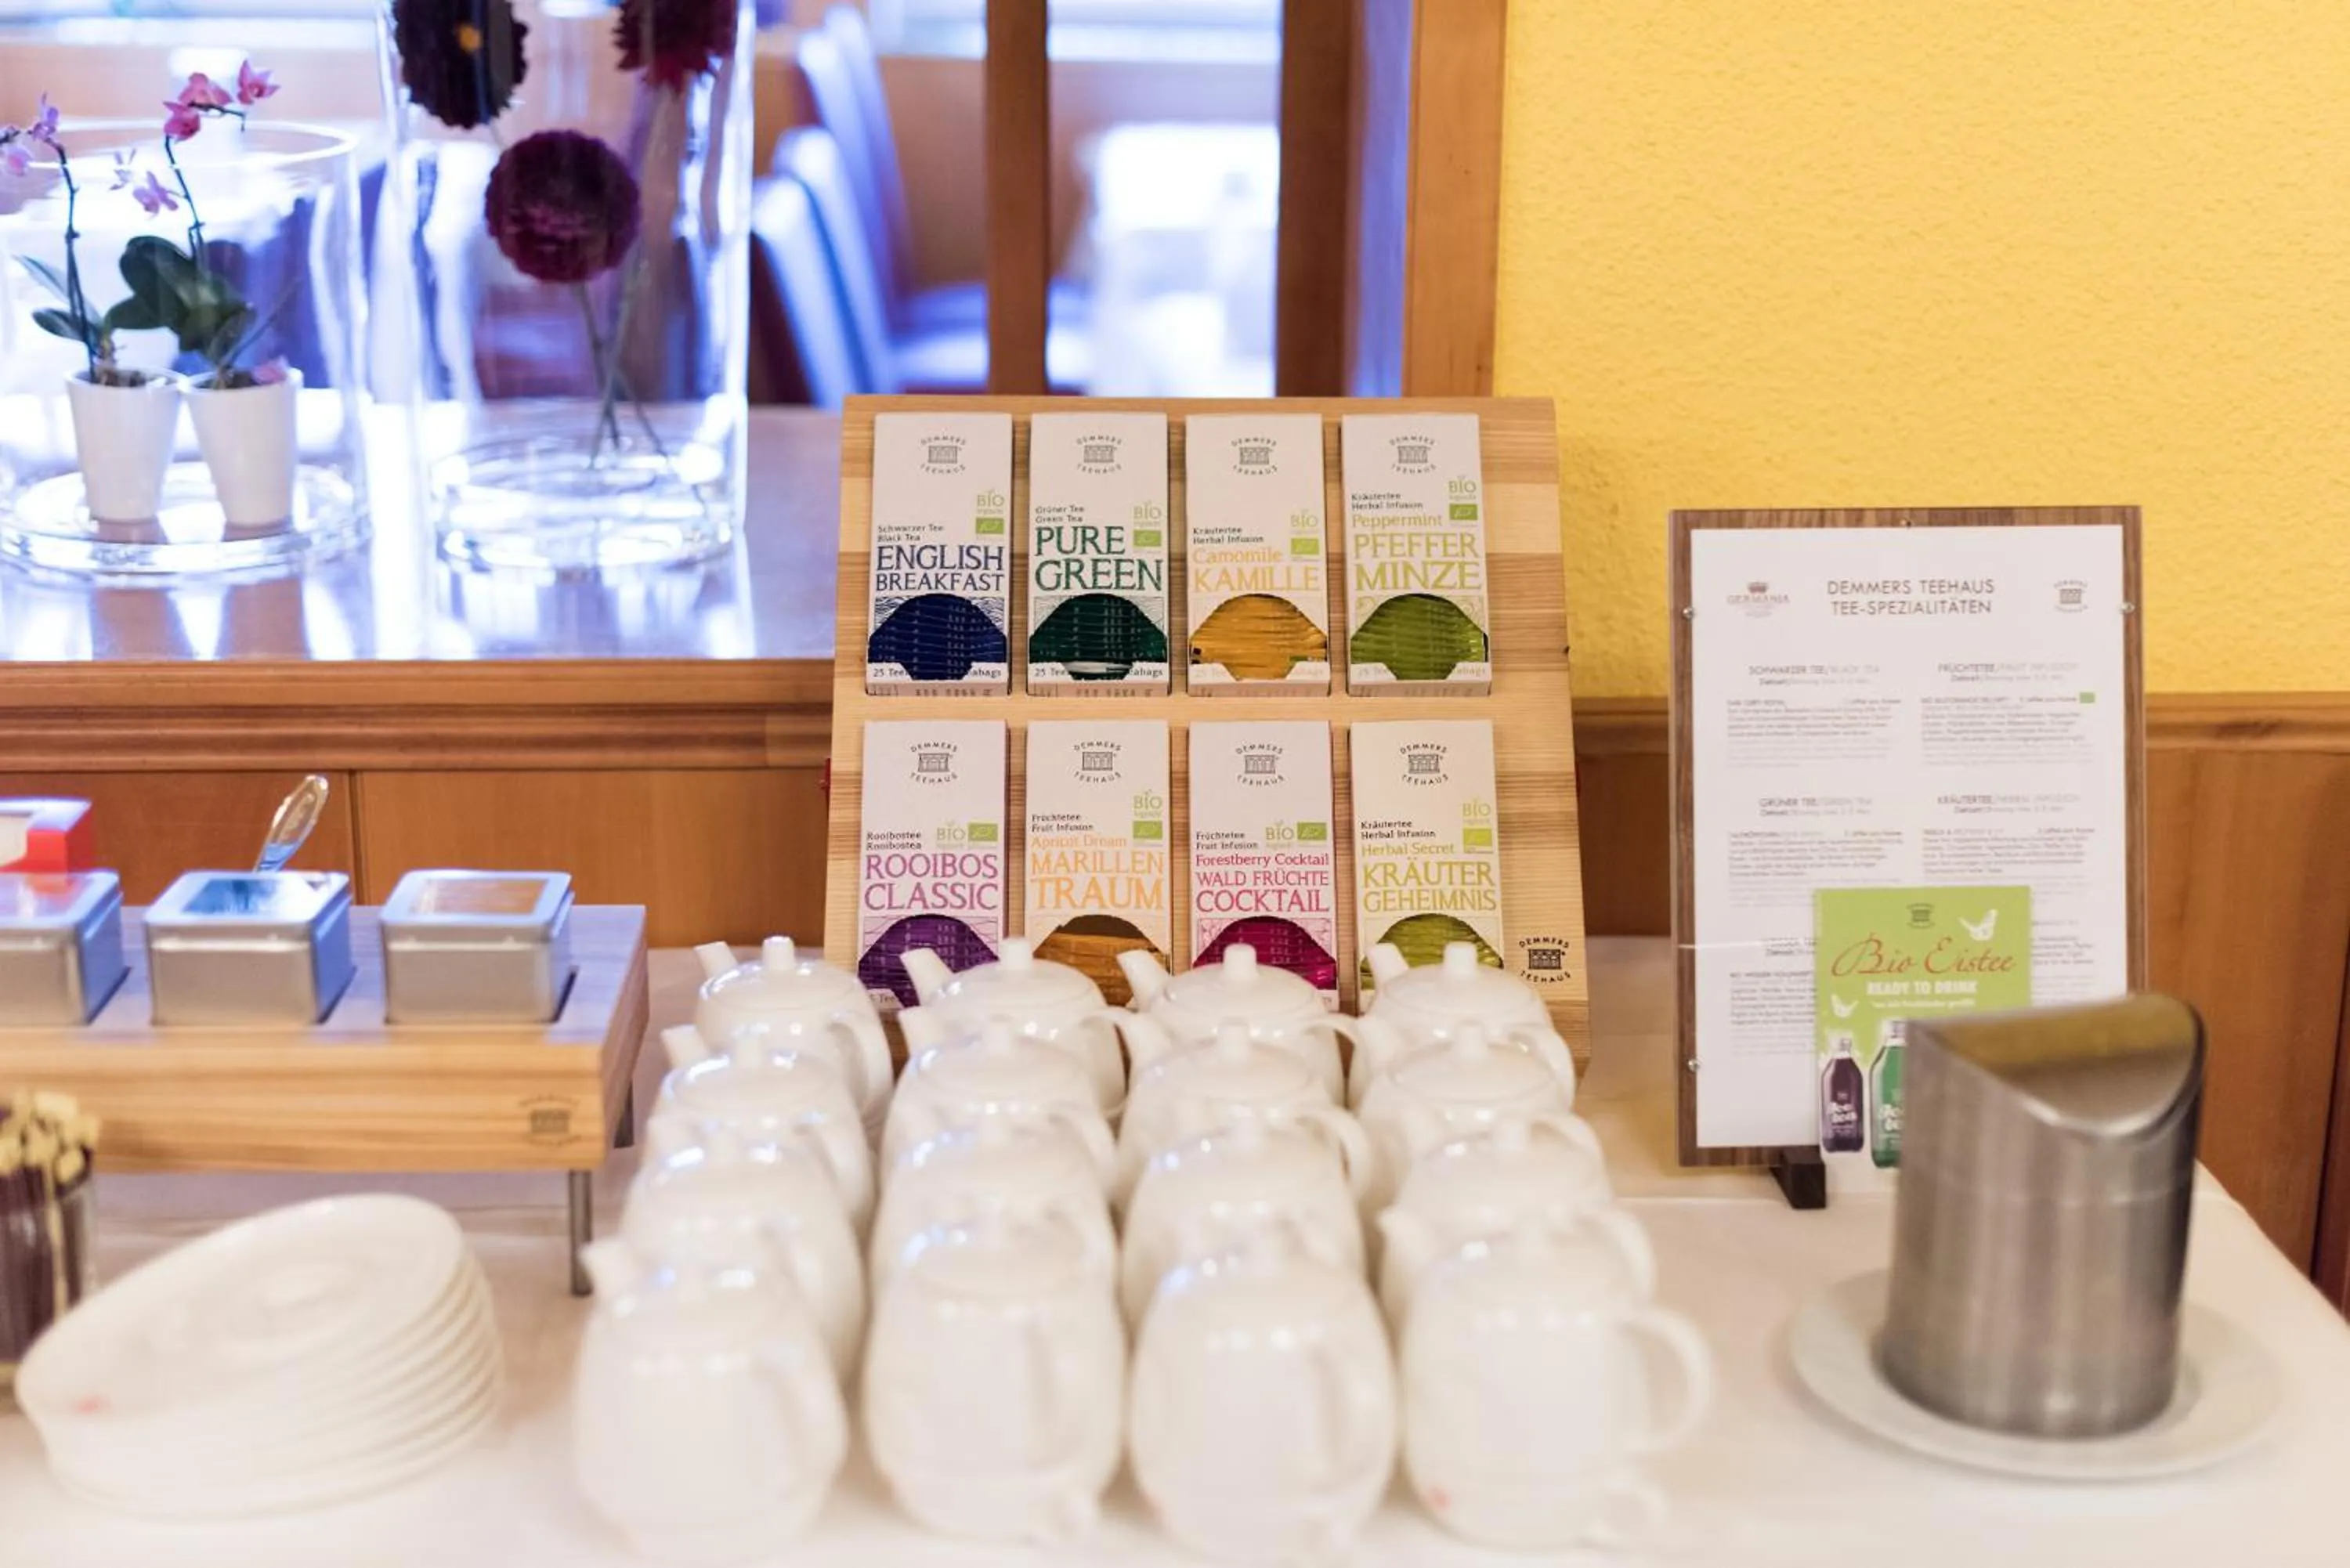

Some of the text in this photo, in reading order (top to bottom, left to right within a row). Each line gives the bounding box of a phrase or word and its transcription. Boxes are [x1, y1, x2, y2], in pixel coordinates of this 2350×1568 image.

[1069, 504, 1084, 513] Tee
[1351, 501, 1383, 510] Herbal
[877, 523, 944, 533] Schwarzer Tee
[1352, 513, 1443, 529] Peppermint
[877, 533, 902, 542] Black
[1035, 526, 1126, 557] PURE
[1193, 536, 1224, 544] Herbal
[1354, 532, 1480, 558] PFEFFER
[877, 544, 1005, 571] ENGLISH
[1193, 547, 1282, 564] Camomile
[875, 573, 1005, 591] BREAKFAST
[1035, 558, 1163, 591] GREEN
[1194, 565, 1320, 592] KAMILLE
[1354, 559, 1483, 591] MINZE
[1827, 579, 1995, 594] DEMMERS TEEHAUS
[1831, 598, 1991, 616] TEE-SPEZIALITÄTEN
[873, 668, 884, 677] 25
[1035, 668, 1046, 677] 25
[909, 742, 958, 753] DEMMERS
[1073, 740, 1122, 751] DEMMERS
[1235, 743, 1284, 754] DEMMERS
[1399, 743, 1448, 754] DEMMERS
[909, 771, 959, 783] TEEHAUS
[1073, 771, 1123, 783] TEEHAUS
[1236, 774, 1285, 786] TEEHAUS
[1401, 773, 1449, 785] TEEHAUS
[1031, 823, 1054, 833] Fruit
[1361, 821, 1412, 829] Kräutertee
[866, 830, 922, 840] Rooibostee
[1031, 834, 1127, 850] Apricot Dream
[1361, 830, 1394, 840] Herbal
[1195, 841, 1217, 850] Fruit
[1361, 842, 1455, 857] Herbal Secret
[865, 853, 999, 880] ROOIBOS
[1031, 850, 1165, 875] MARILLEN
[1195, 852, 1329, 868] Forestberry Cocktail
[1196, 867, 1329, 887] WALD FRÜCHTE
[1362, 856, 1495, 888] KRÄUTER
[864, 882, 999, 911] CLASSIC
[1030, 876, 1165, 910] TRAUM
[1196, 889, 1330, 912] COCKTAIL
[1362, 889, 1497, 912] GEHEIMNIS
[1518, 937, 1569, 948] DEMMERS
[1831, 932, 1917, 977] Bio
[1924, 935, 2016, 974] Eistee
[1520, 970, 1571, 983] TEEHAUS
[1867, 980, 1978, 995] READY TO DRINK
